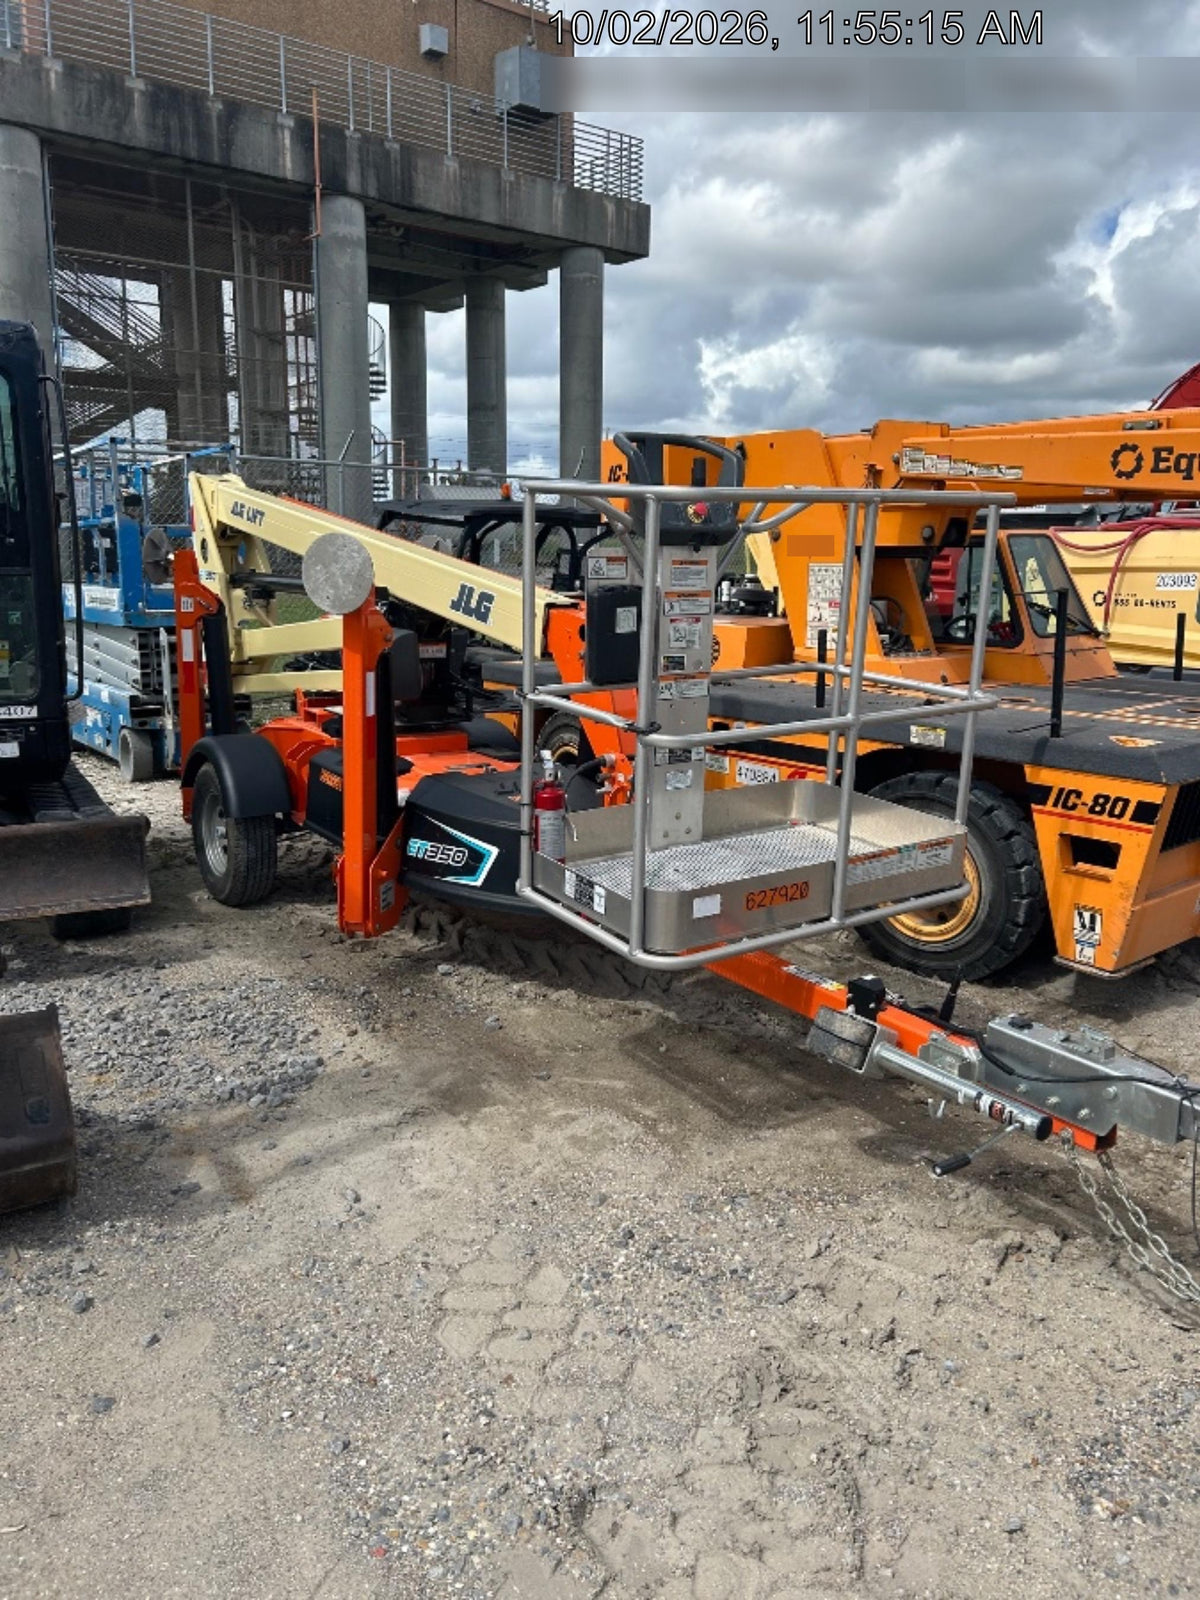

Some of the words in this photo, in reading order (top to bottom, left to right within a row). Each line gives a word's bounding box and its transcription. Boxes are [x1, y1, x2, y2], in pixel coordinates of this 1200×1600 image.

[1150, 446, 1200, 481] Eq
[448, 581, 496, 626] JLG
[1052, 787, 1132, 820] IC-80
[406, 838, 469, 868] ET350
[745, 881, 809, 911] 627920
